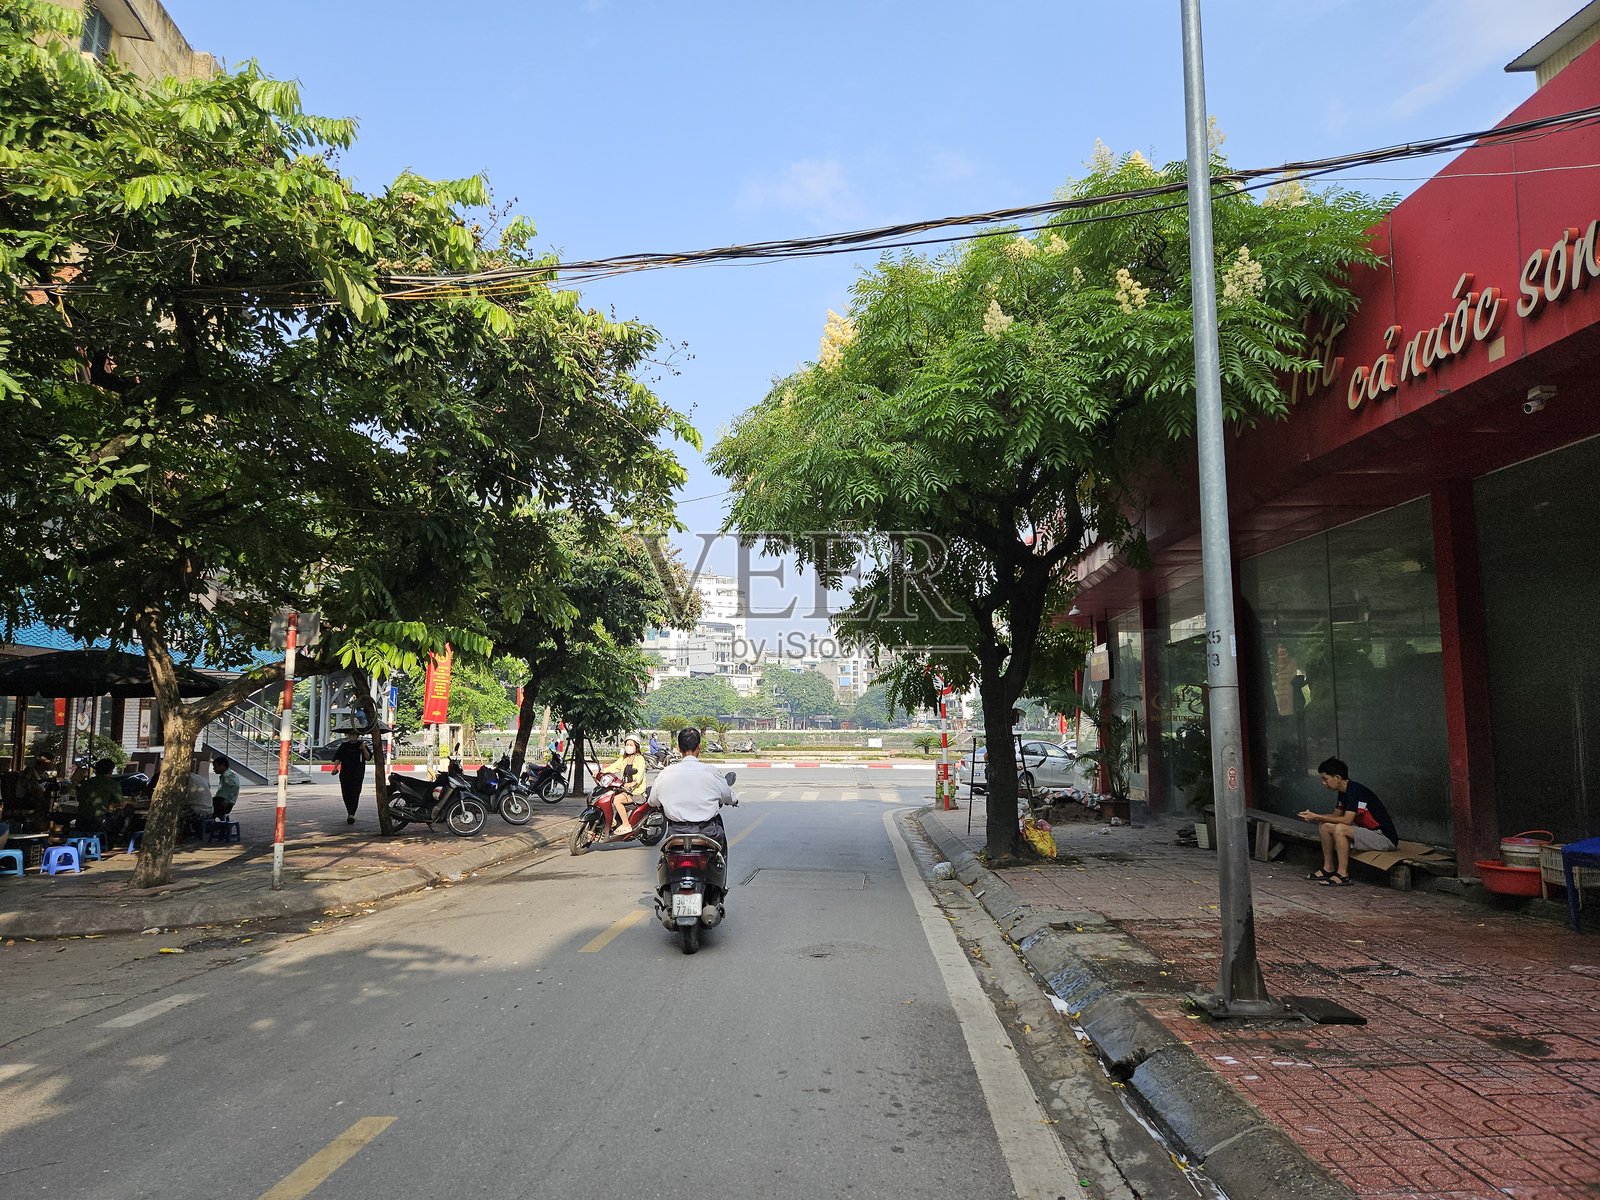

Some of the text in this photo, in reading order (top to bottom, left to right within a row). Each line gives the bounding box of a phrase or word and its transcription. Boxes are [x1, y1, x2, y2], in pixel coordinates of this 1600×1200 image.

[1347, 325, 1397, 411] cả
[1401, 272, 1505, 382] nước
[1516, 219, 1600, 318] sơn
